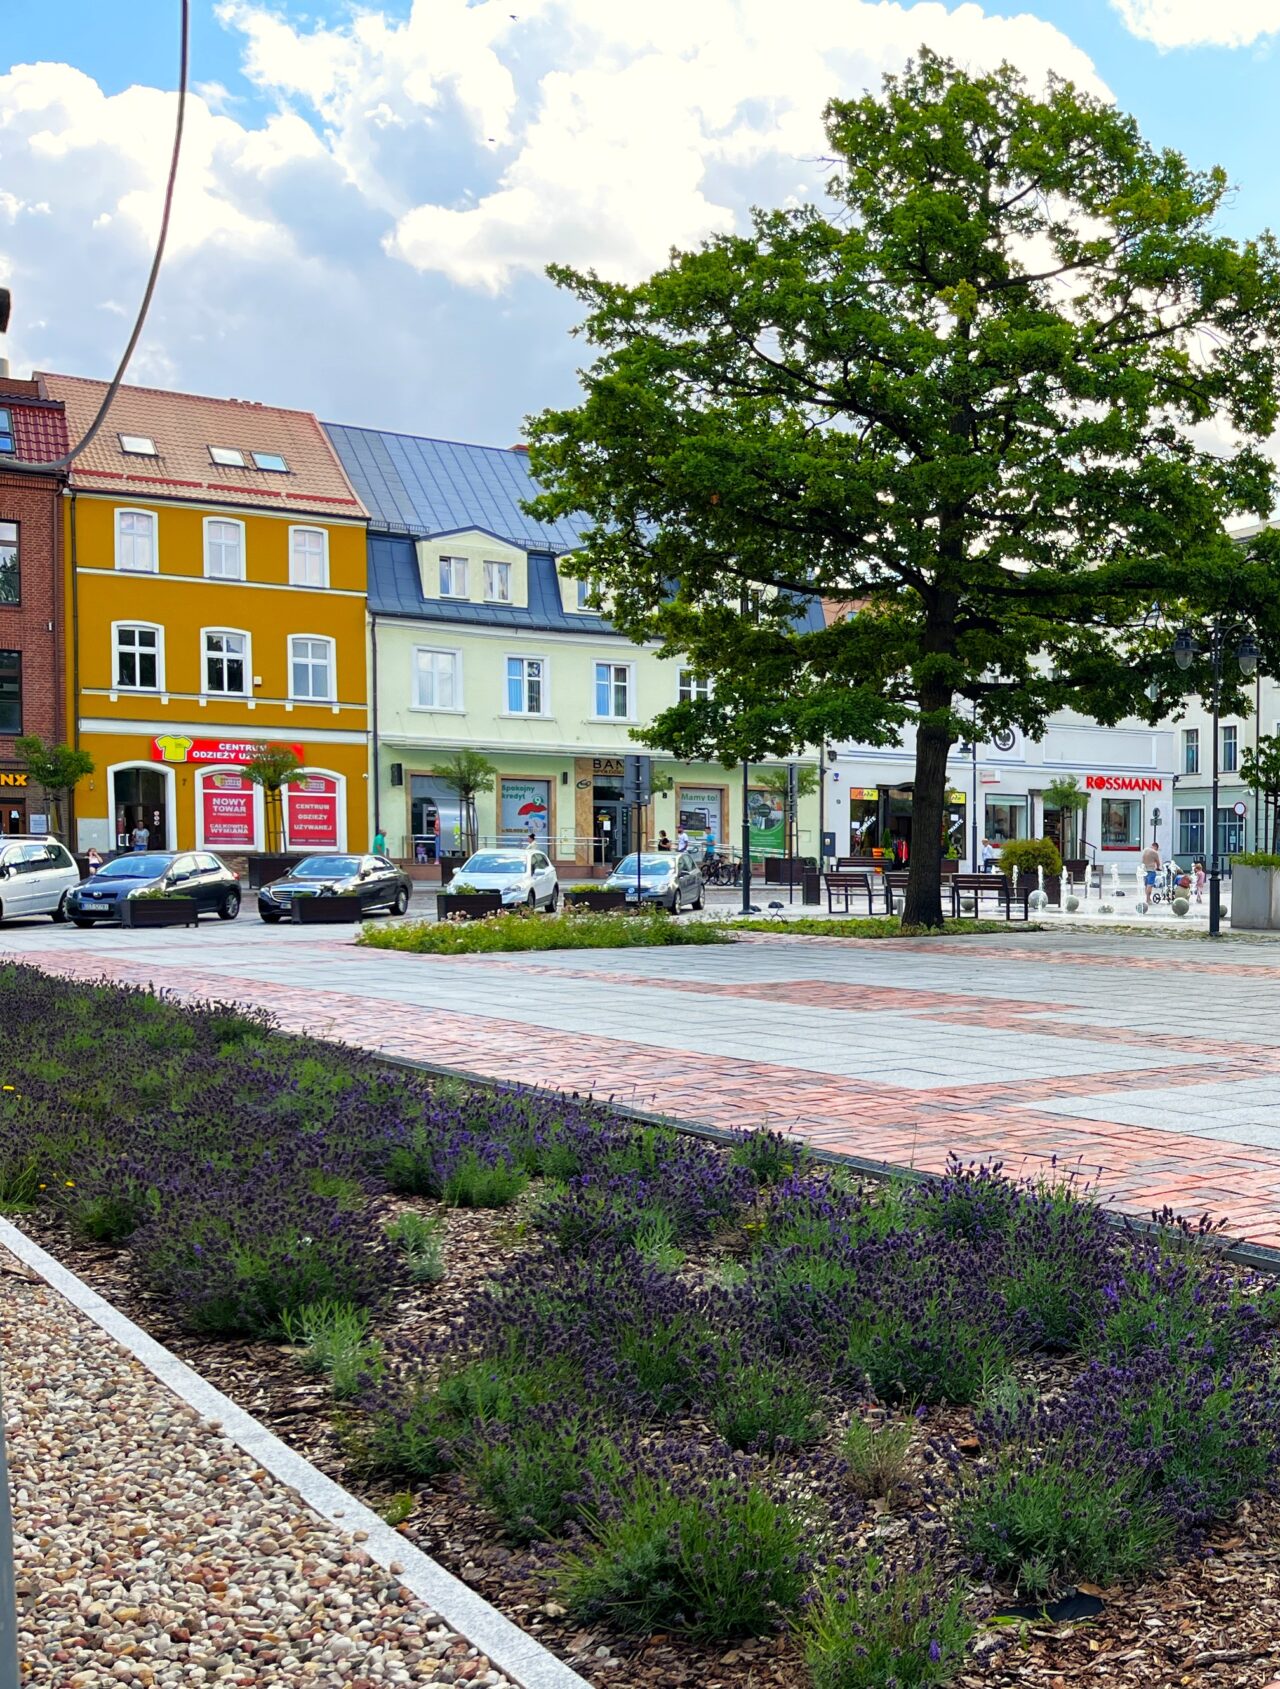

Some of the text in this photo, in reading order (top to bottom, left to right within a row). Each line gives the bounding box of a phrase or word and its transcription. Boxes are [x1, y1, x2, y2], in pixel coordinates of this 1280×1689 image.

[193, 750, 236, 759] ODZIEŻY
[593, 759, 624, 769] BAN
[1086, 775, 1162, 791] ROSSMANN
[212, 798, 246, 806] NOWY
[682, 793, 718, 803] Mamy to!
[213, 805, 247, 813] TOWAR
